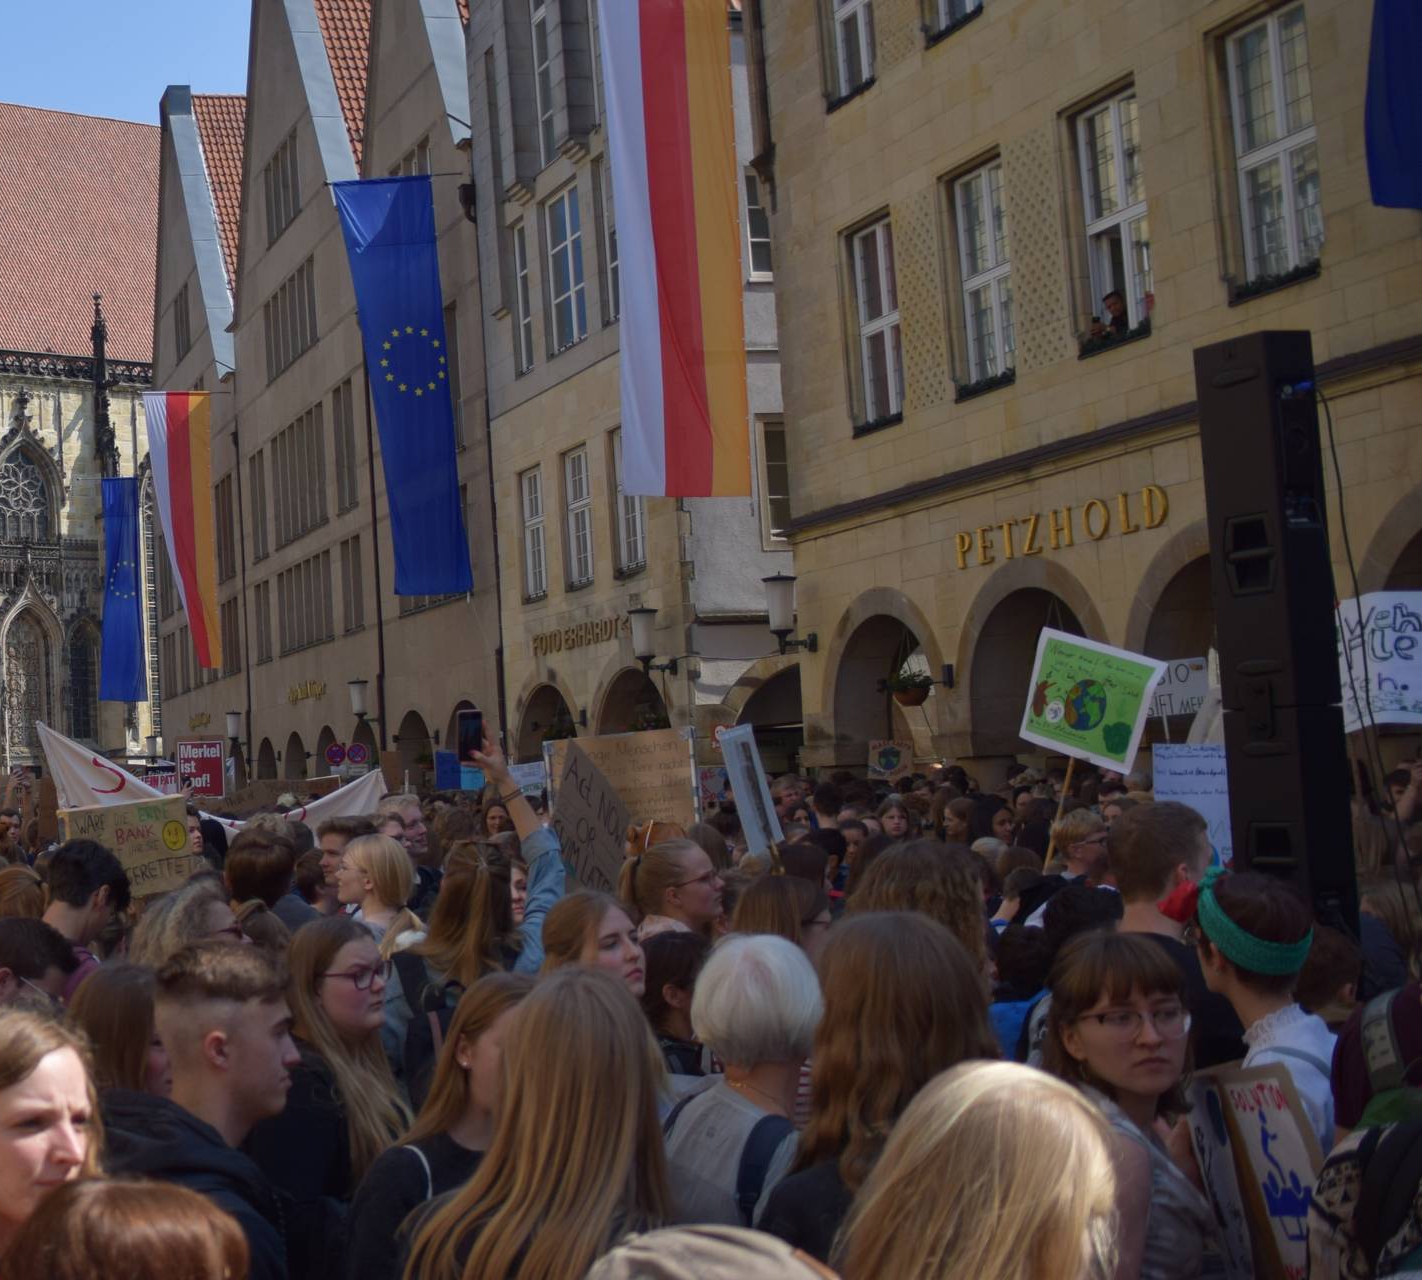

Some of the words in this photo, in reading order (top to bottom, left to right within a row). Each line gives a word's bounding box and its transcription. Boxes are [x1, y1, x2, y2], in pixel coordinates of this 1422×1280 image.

[954, 484, 1169, 569] PETZHOLD
[532, 629, 562, 657] FOTO
[564, 615, 619, 651] ERHARDT
[180, 744, 220, 758] Merkel
[181, 760, 196, 773] ist
[186, 773, 210, 788] oof!
[115, 824, 155, 845] BANK
